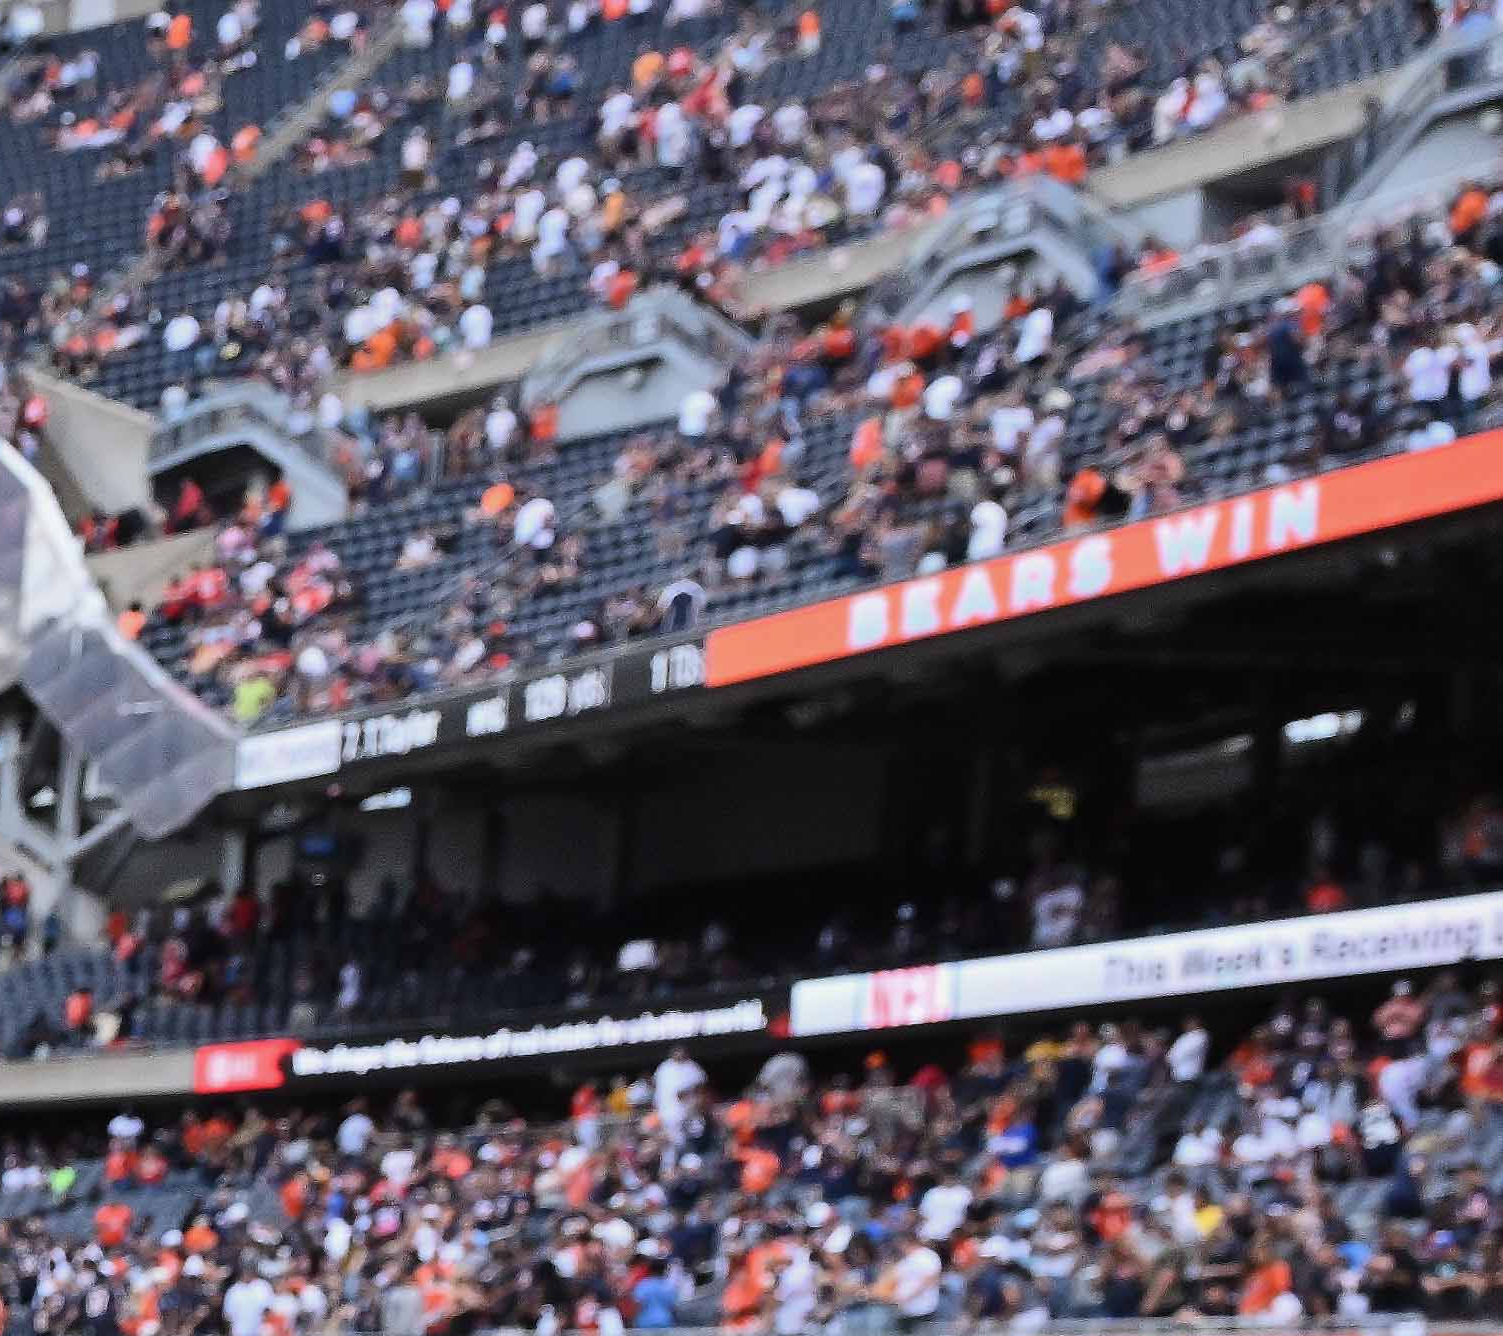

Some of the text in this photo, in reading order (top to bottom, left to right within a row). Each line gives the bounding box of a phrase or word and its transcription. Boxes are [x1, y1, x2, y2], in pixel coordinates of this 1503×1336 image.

[844, 483, 1322, 652] BEARS WIN
[1103, 919, 1483, 986] This Week's Receiving
